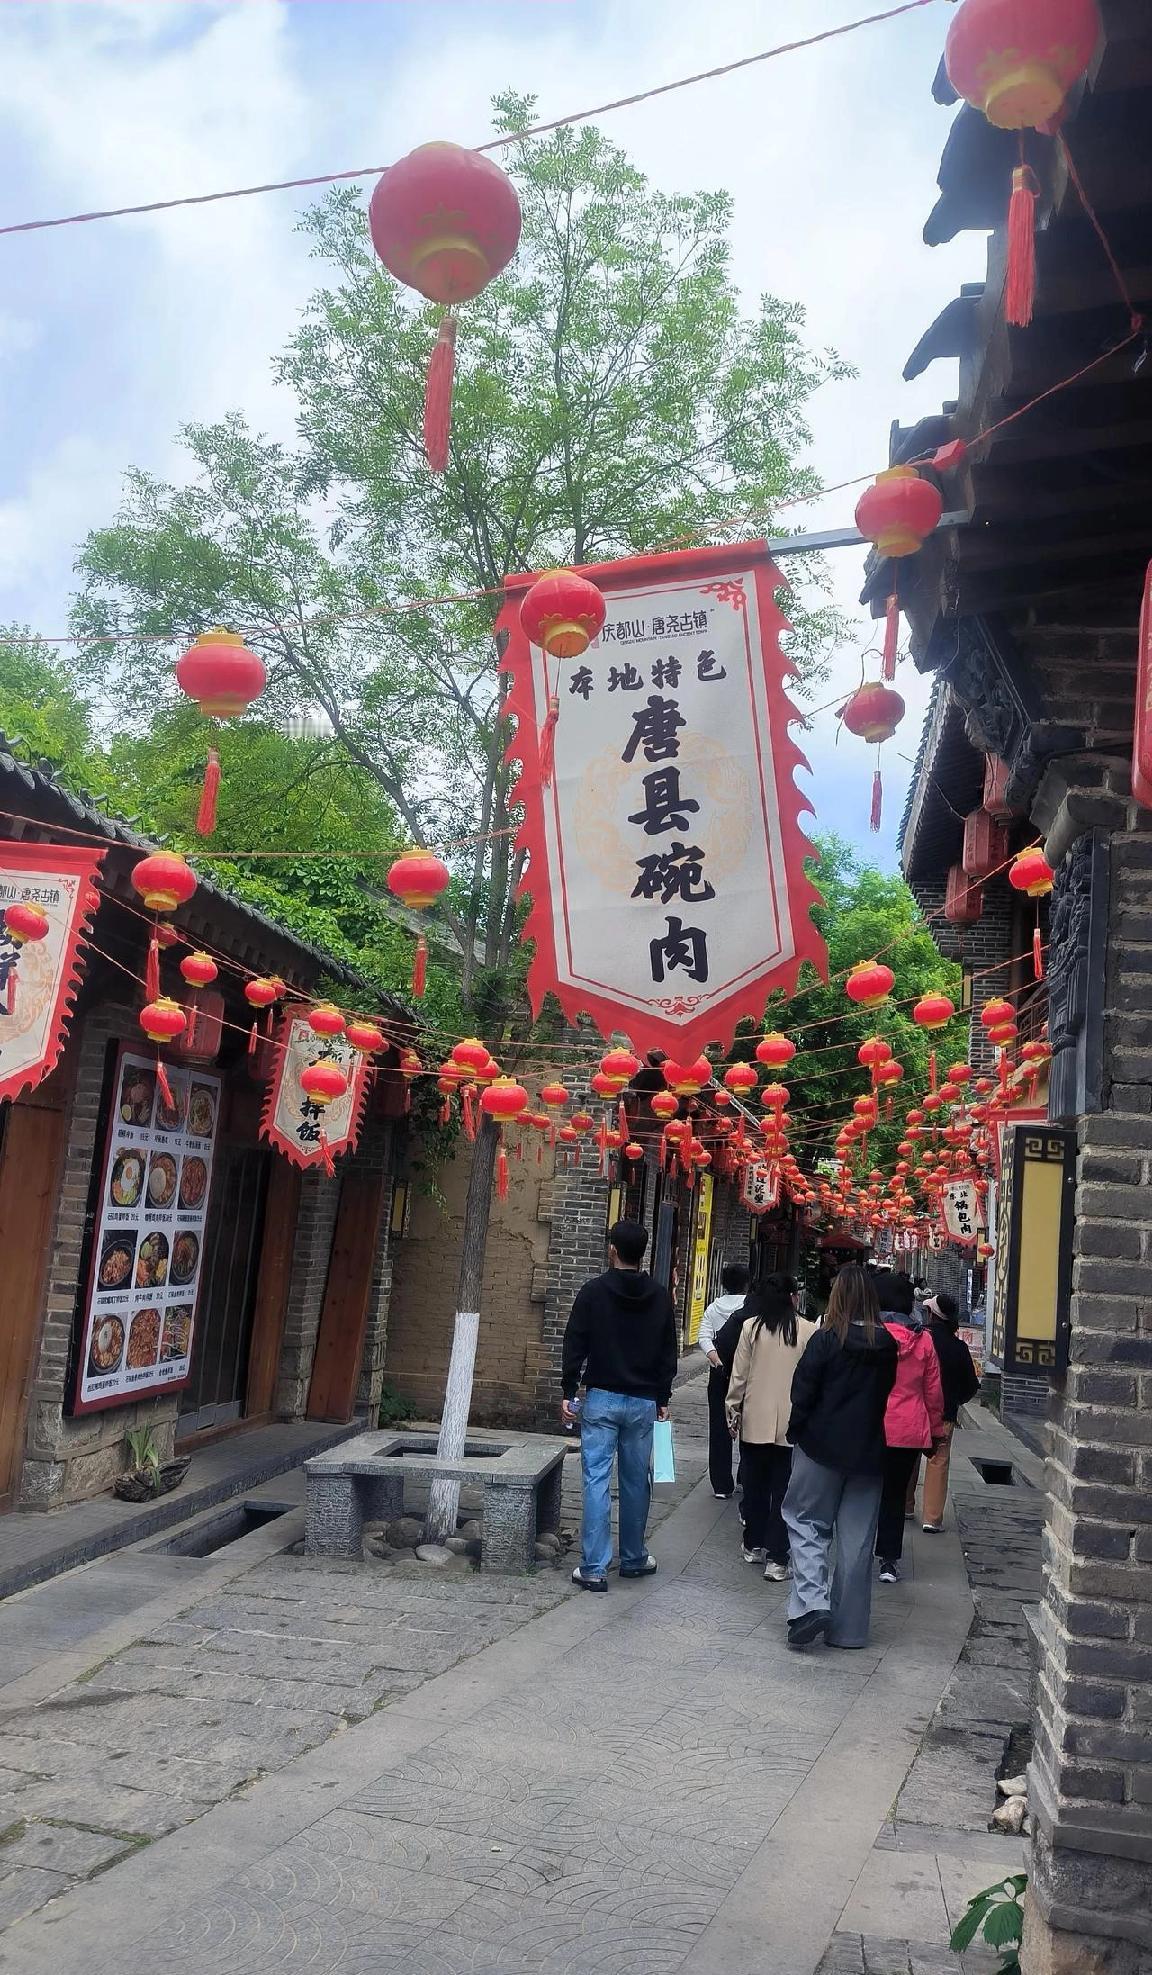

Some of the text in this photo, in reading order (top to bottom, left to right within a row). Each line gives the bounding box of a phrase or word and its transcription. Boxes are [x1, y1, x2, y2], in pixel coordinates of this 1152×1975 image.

[568, 649, 727, 700] 本地特色
[621, 695, 716, 984] 唐县碗肉
[954, 1201, 972, 1235] 锅包肉
